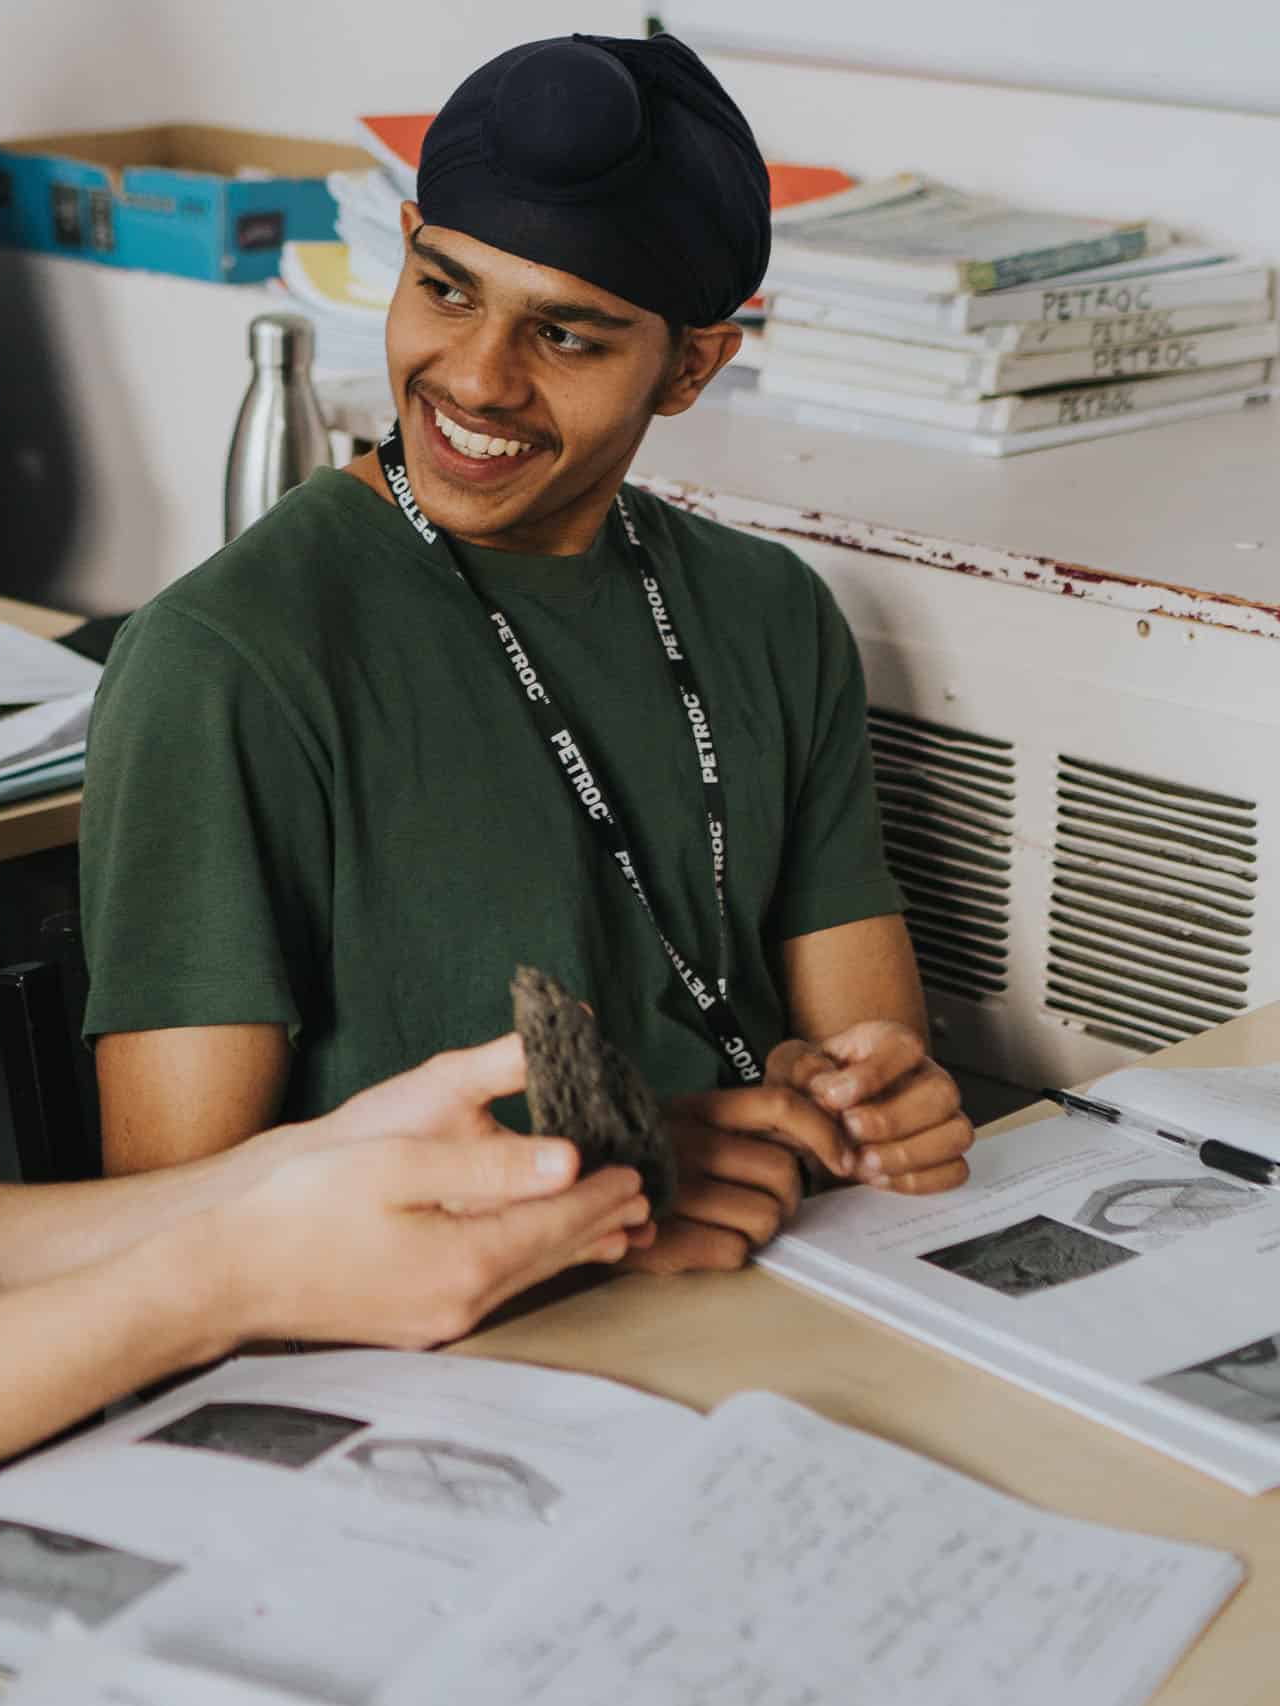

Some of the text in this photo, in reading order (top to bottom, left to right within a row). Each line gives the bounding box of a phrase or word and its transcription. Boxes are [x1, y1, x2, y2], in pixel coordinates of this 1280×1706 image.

[1041, 284, 1153, 321] PETROC
[1093, 341, 1201, 376] PETROC
[386, 464, 438, 545] PETROC
[490, 612, 545, 701] PETROC
[642, 577, 684, 661] PETROC
[550, 729, 609, 820] PETROC
[682, 693, 719, 784] PETROC
